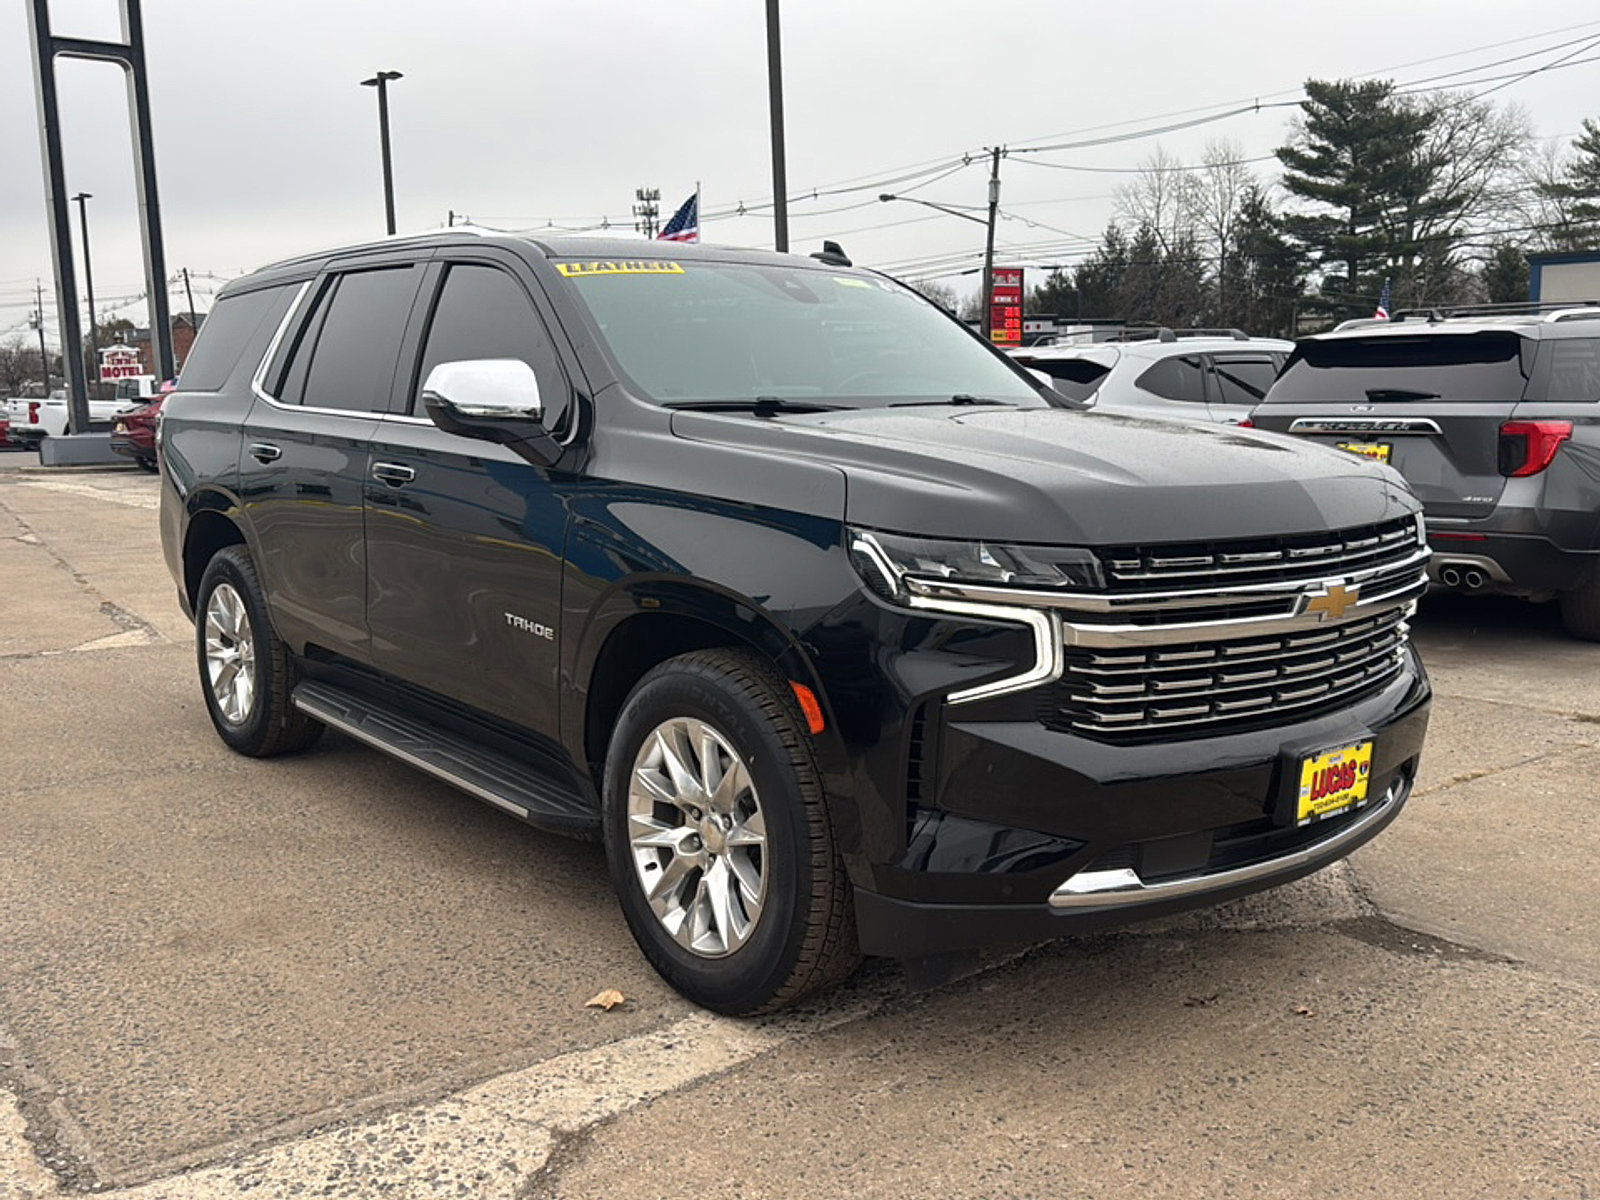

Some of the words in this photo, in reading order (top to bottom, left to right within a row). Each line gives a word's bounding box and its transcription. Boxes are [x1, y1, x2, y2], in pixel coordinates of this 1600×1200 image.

[565, 261, 676, 273] LEATHER
[101, 366, 141, 378] MOTEL
[504, 612, 554, 640] TAHOE
[1310, 759, 1357, 801] LUCAS
